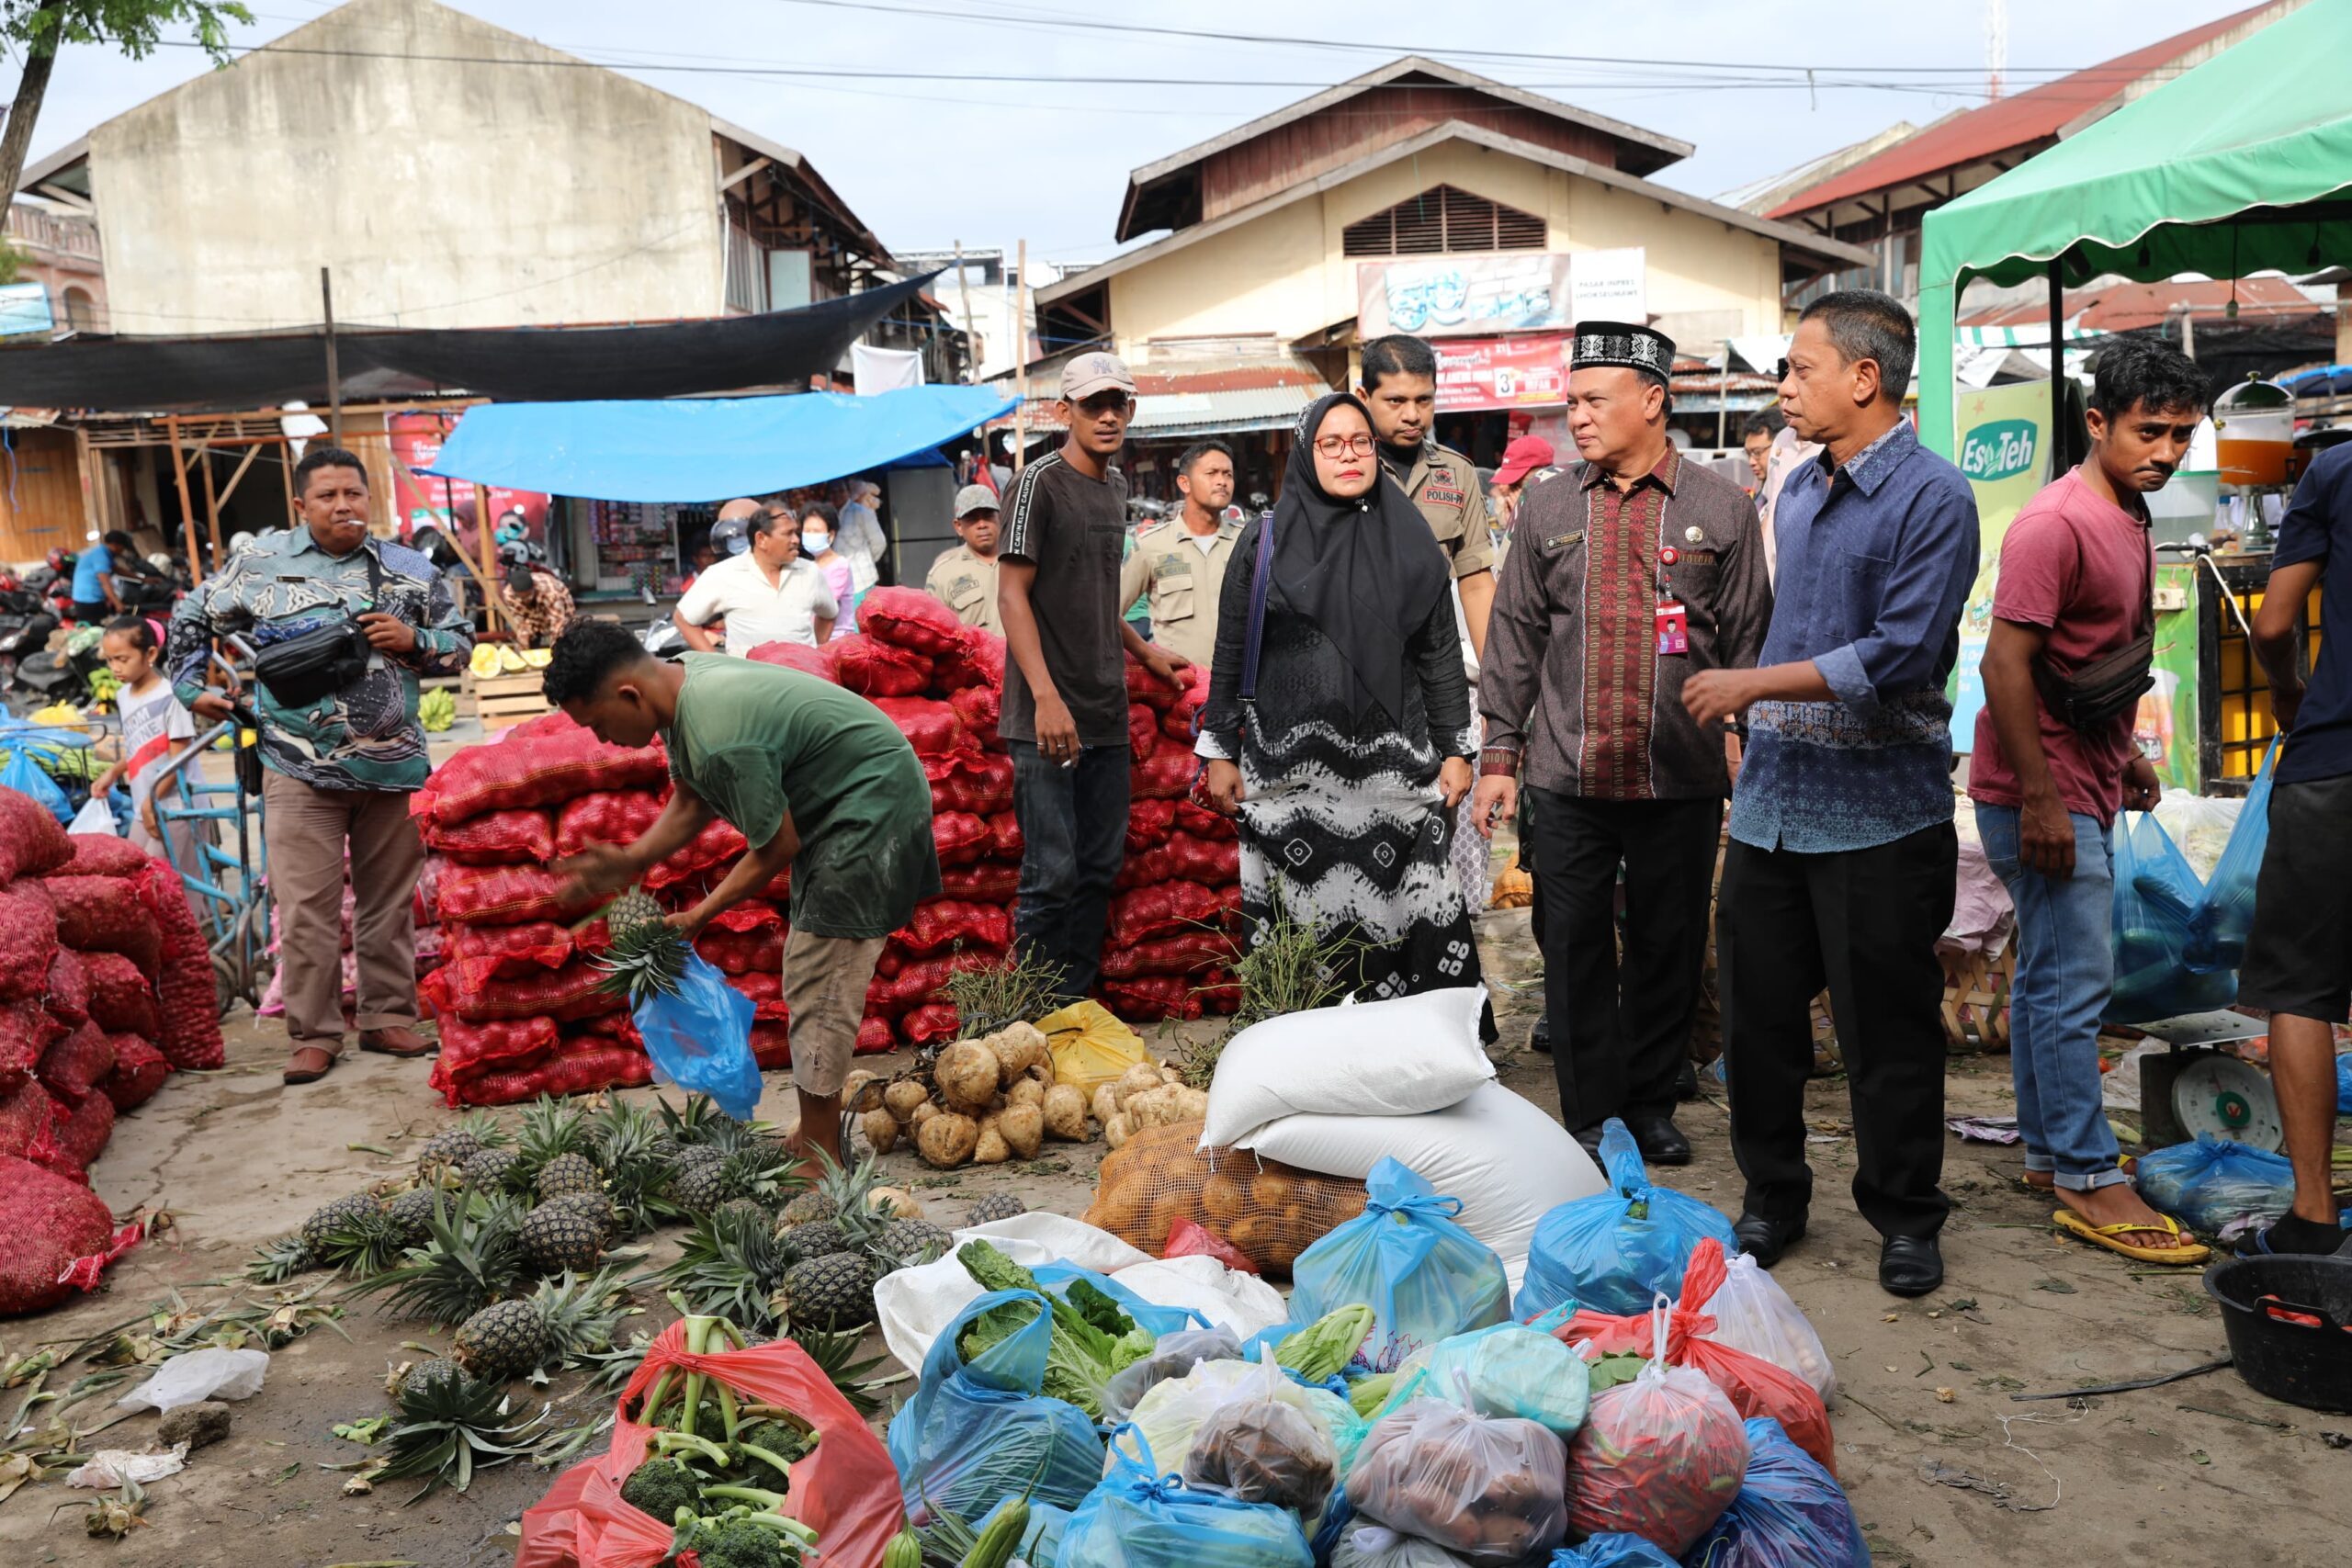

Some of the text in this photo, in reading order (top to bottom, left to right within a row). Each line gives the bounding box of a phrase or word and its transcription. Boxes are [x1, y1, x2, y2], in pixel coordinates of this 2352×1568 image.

[1499, 373, 1510, 394] 3
[1962, 429, 2033, 474] Es Teh
[1022, 479, 1032, 503] CALVIN
[1017, 505, 1026, 525] KLEIN
[1013, 524, 1023, 547] CALVIN
